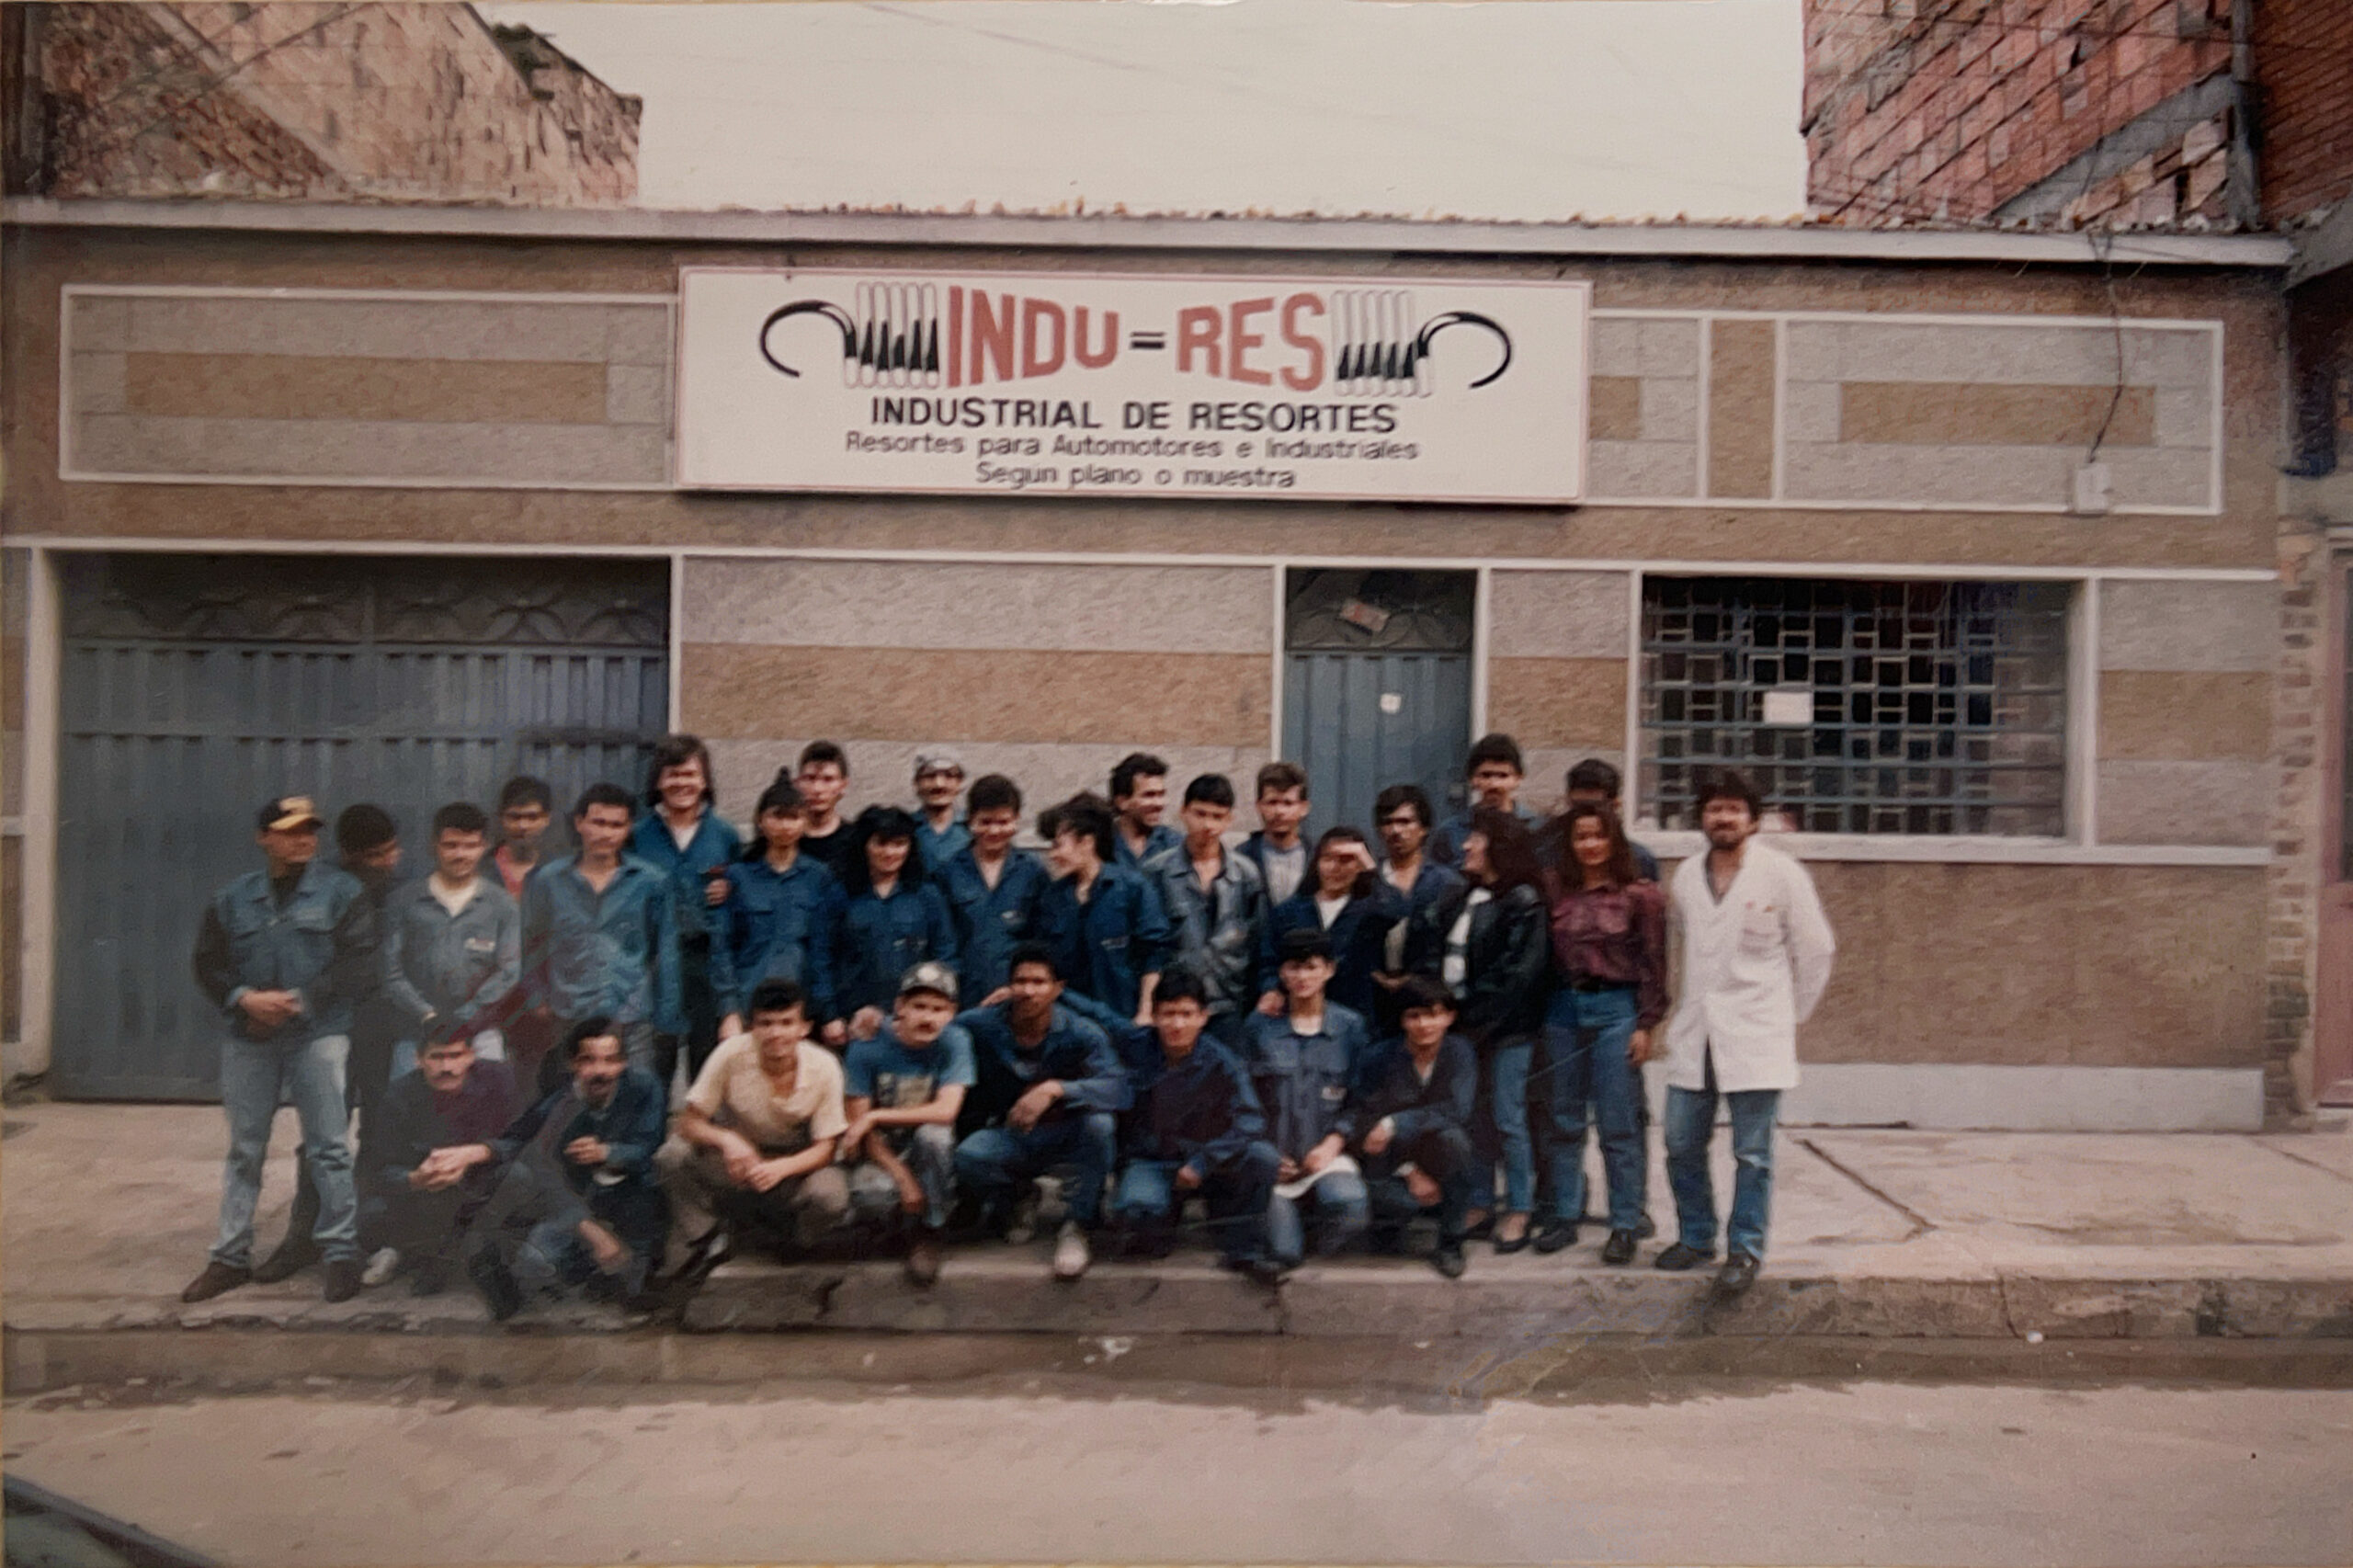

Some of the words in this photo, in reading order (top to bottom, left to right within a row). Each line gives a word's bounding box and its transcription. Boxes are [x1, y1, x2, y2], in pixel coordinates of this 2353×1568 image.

[871, 396, 1102, 428] INDUSTRIAL
[1122, 401, 1170, 429] DE
[1189, 402, 1397, 432] RESORTES
[846, 430, 964, 453] Resortes
[977, 437, 1041, 458] para
[1052, 435, 1222, 458] Automotores
[1236, 441, 1252, 458] e
[1265, 436, 1420, 460] Industriales
[1068, 463, 1142, 487] plano
[1154, 470, 1172, 485] o
[1181, 466, 1296, 488] muestra
